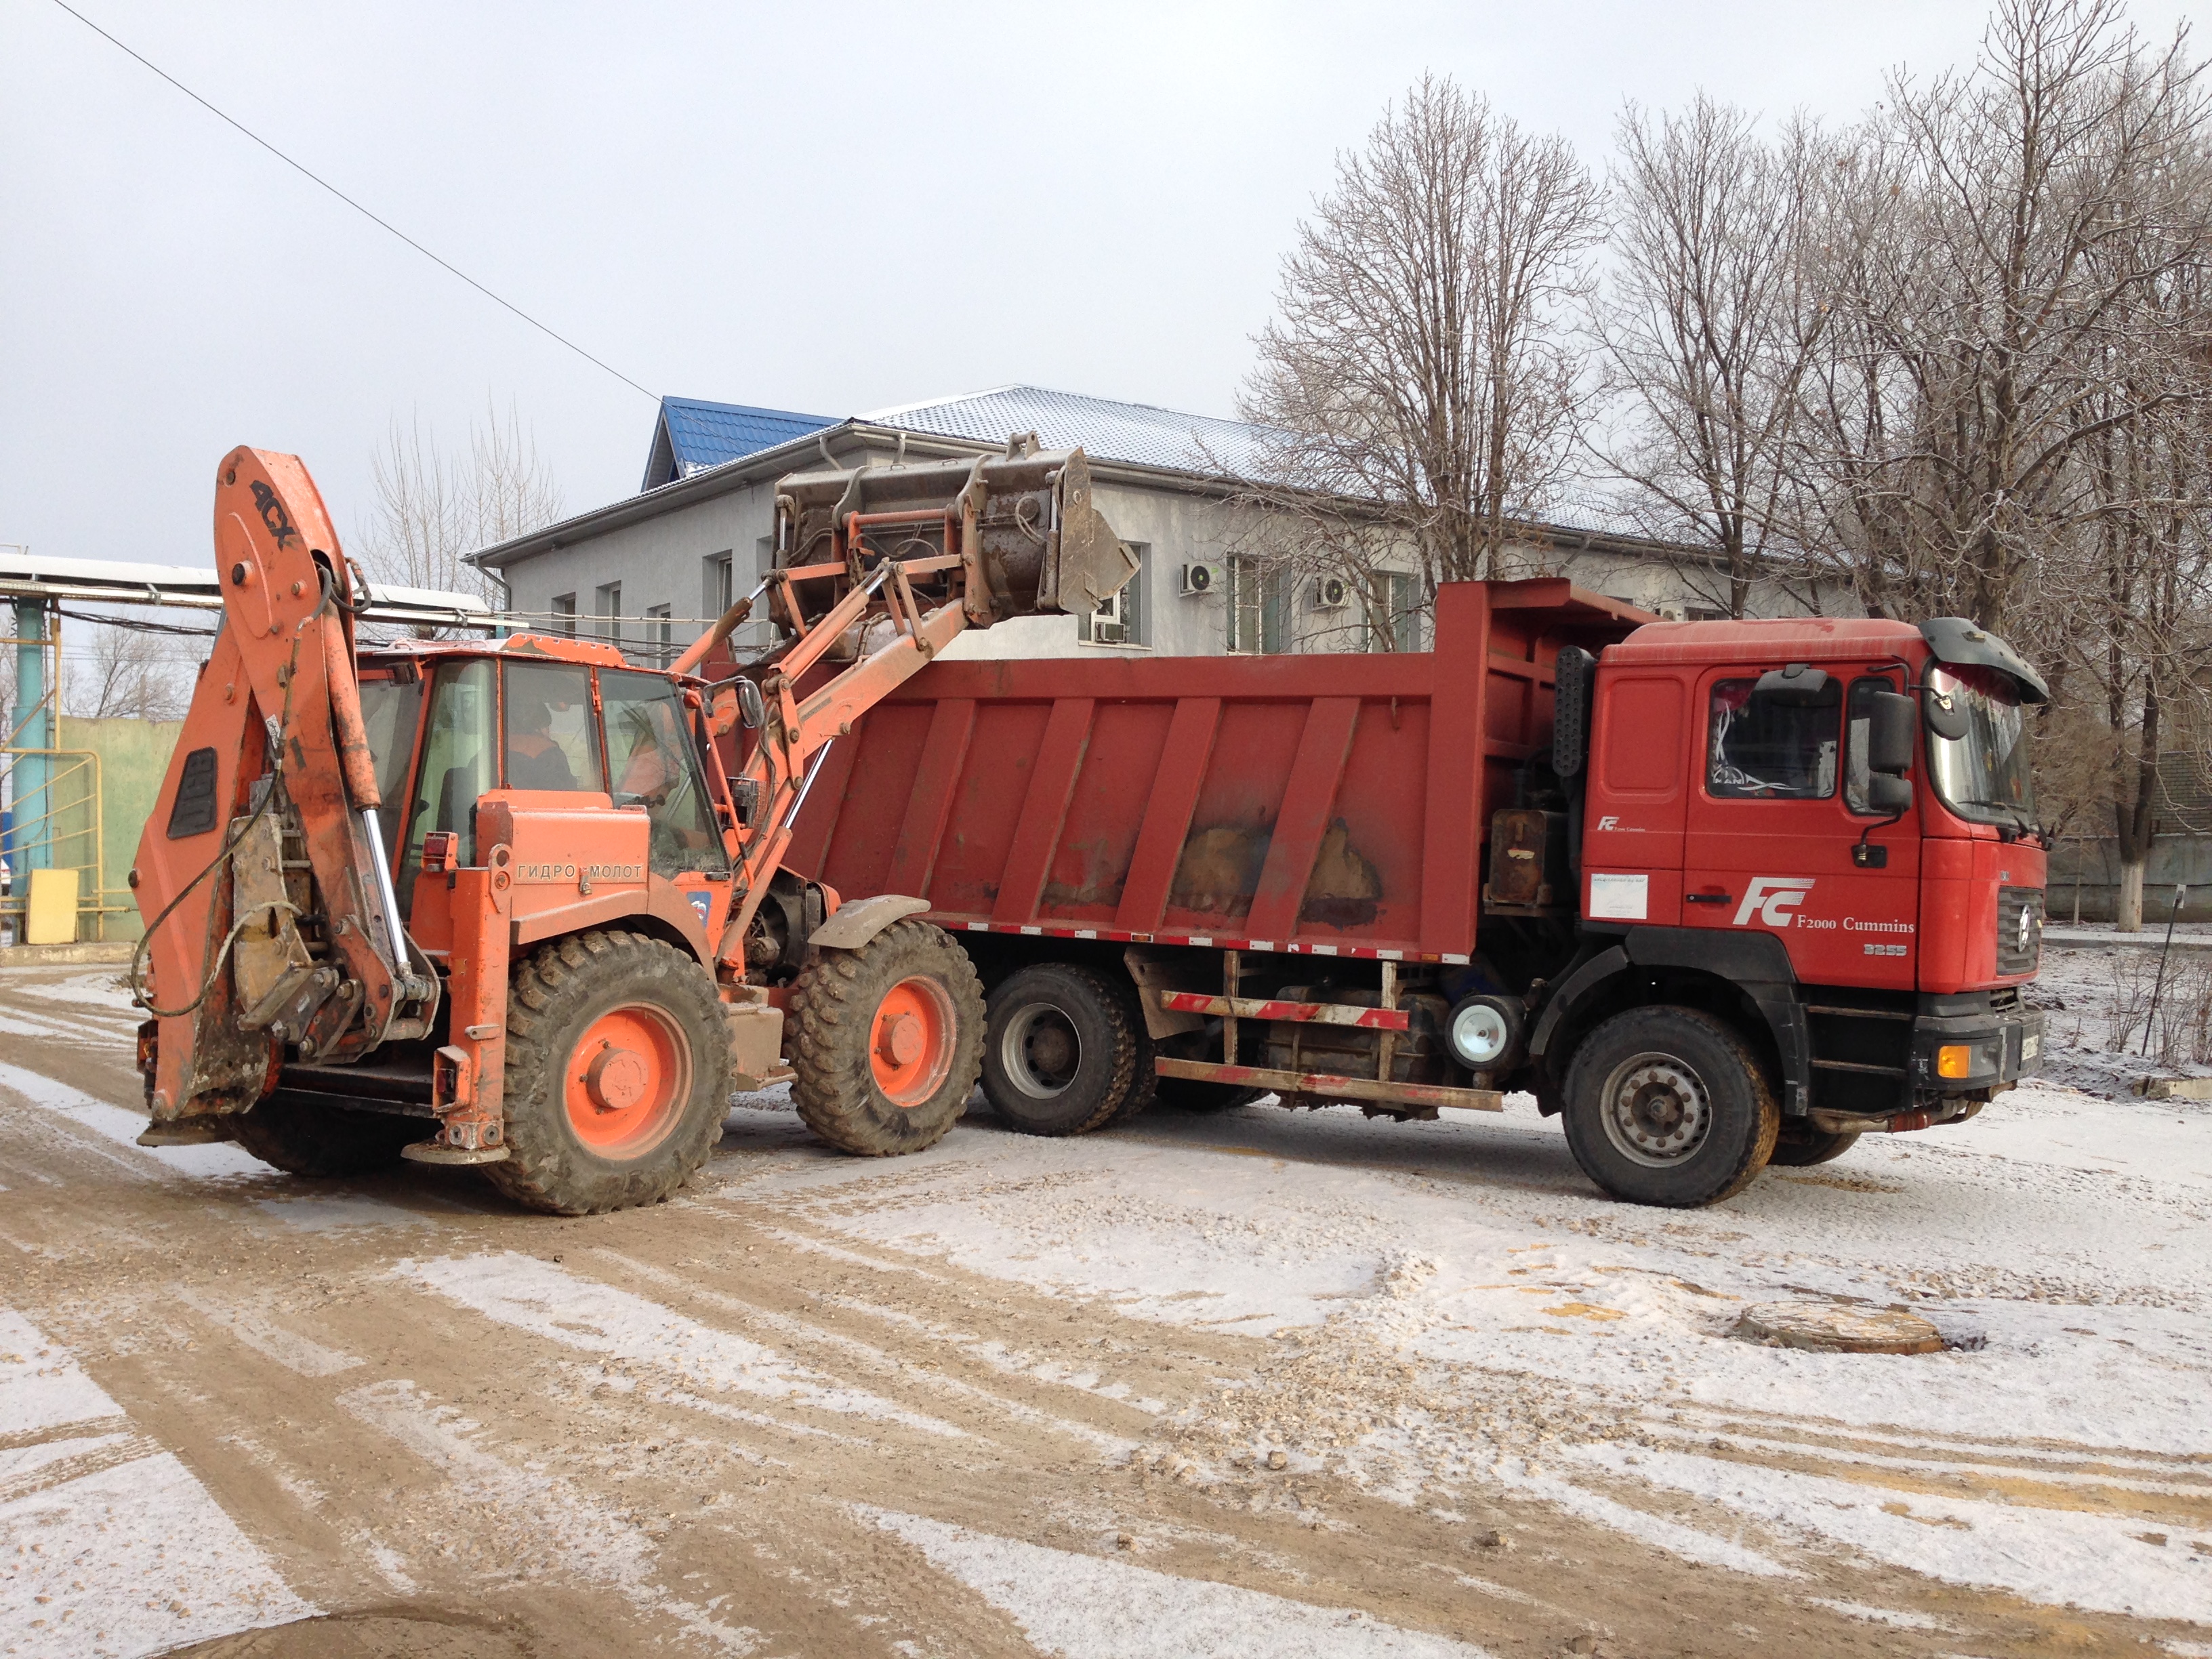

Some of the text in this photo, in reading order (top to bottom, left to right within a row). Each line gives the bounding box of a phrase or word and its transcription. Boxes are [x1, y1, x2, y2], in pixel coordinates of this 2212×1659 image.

[1597, 816, 1620, 830] FC
[516, 864, 642, 880] ГИДРО МОЛОТ
[1732, 876, 1816, 927] FC
[1797, 915, 1915, 933] F2000 Cummins
[1863, 943, 1908, 956] 3255
